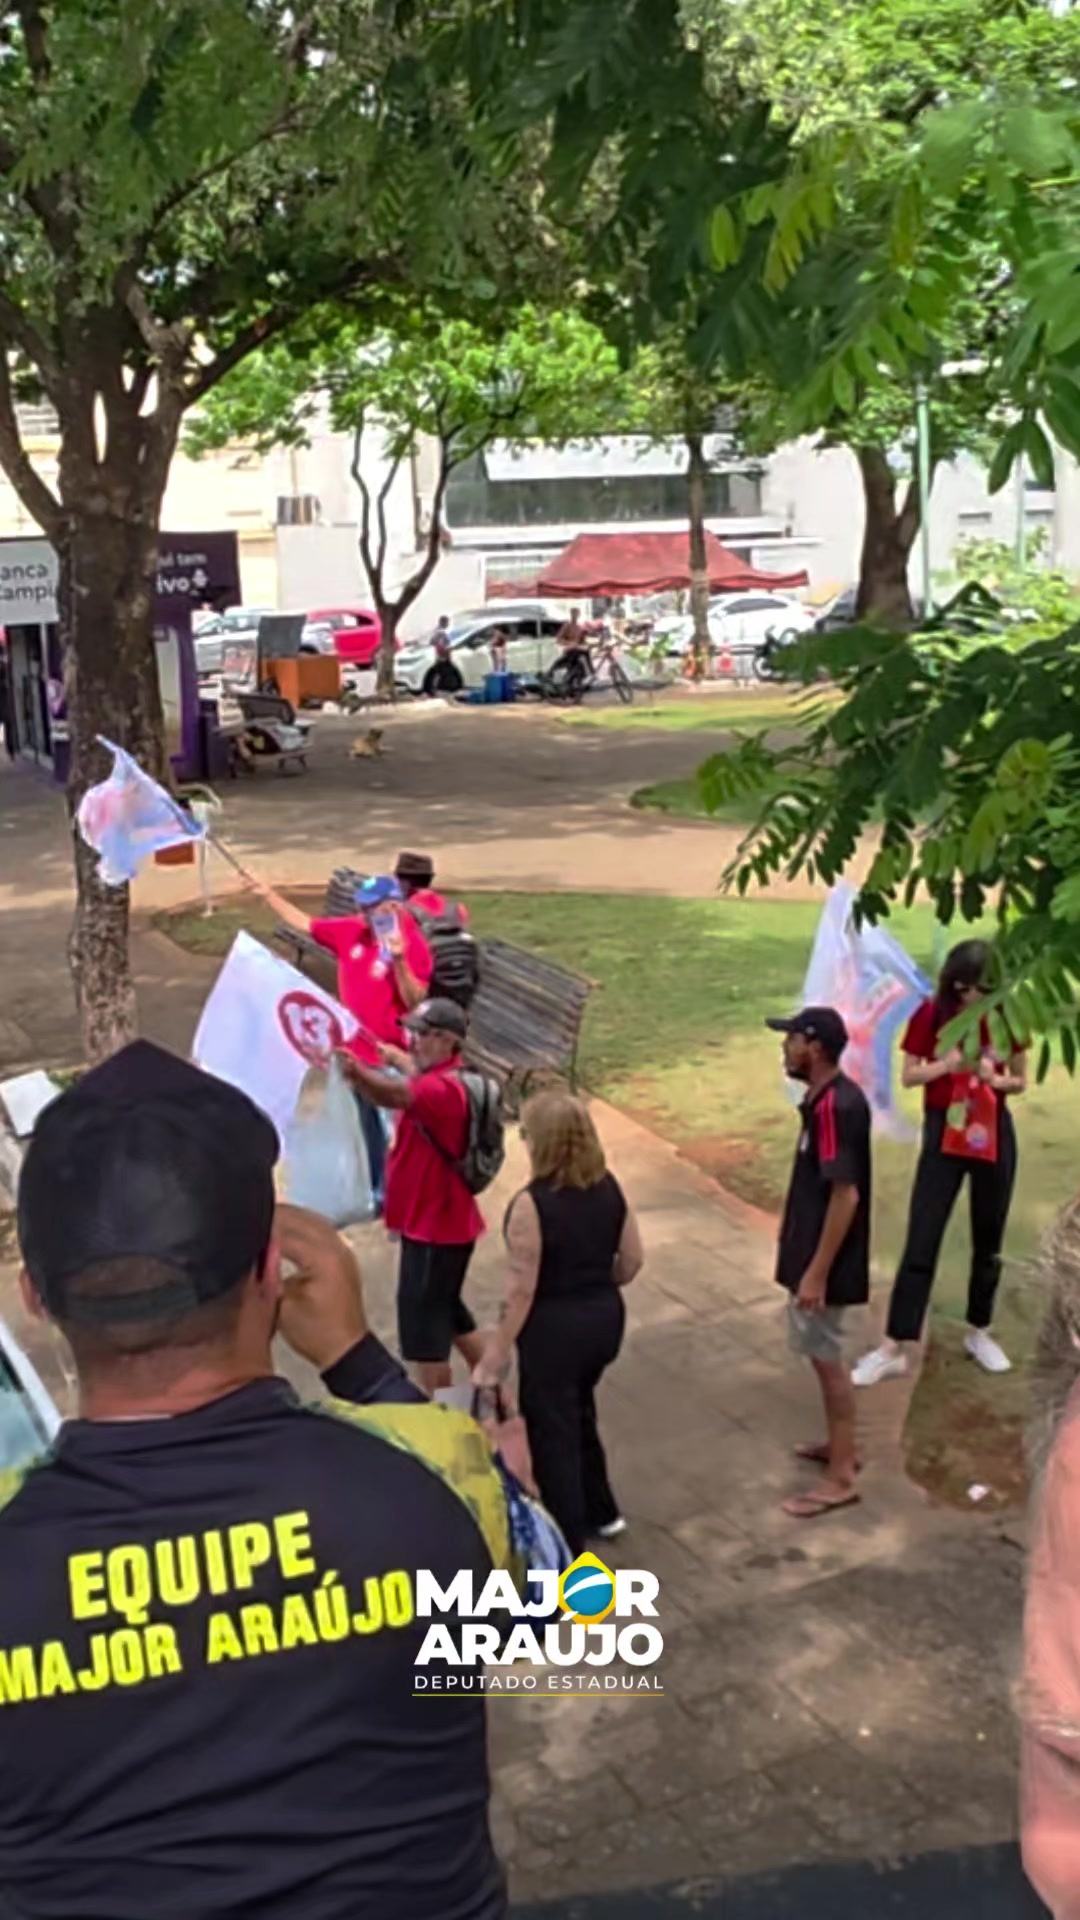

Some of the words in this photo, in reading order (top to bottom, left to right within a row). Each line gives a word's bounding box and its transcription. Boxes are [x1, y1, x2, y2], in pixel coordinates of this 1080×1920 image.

[0, 563, 48, 580] anca
[157, 573, 190, 594] ivo
[68, 1510, 316, 1625] EQUIPE
[0, 1623, 183, 1705] MAJOR
[207, 1569, 414, 1664] ARAÚJO
